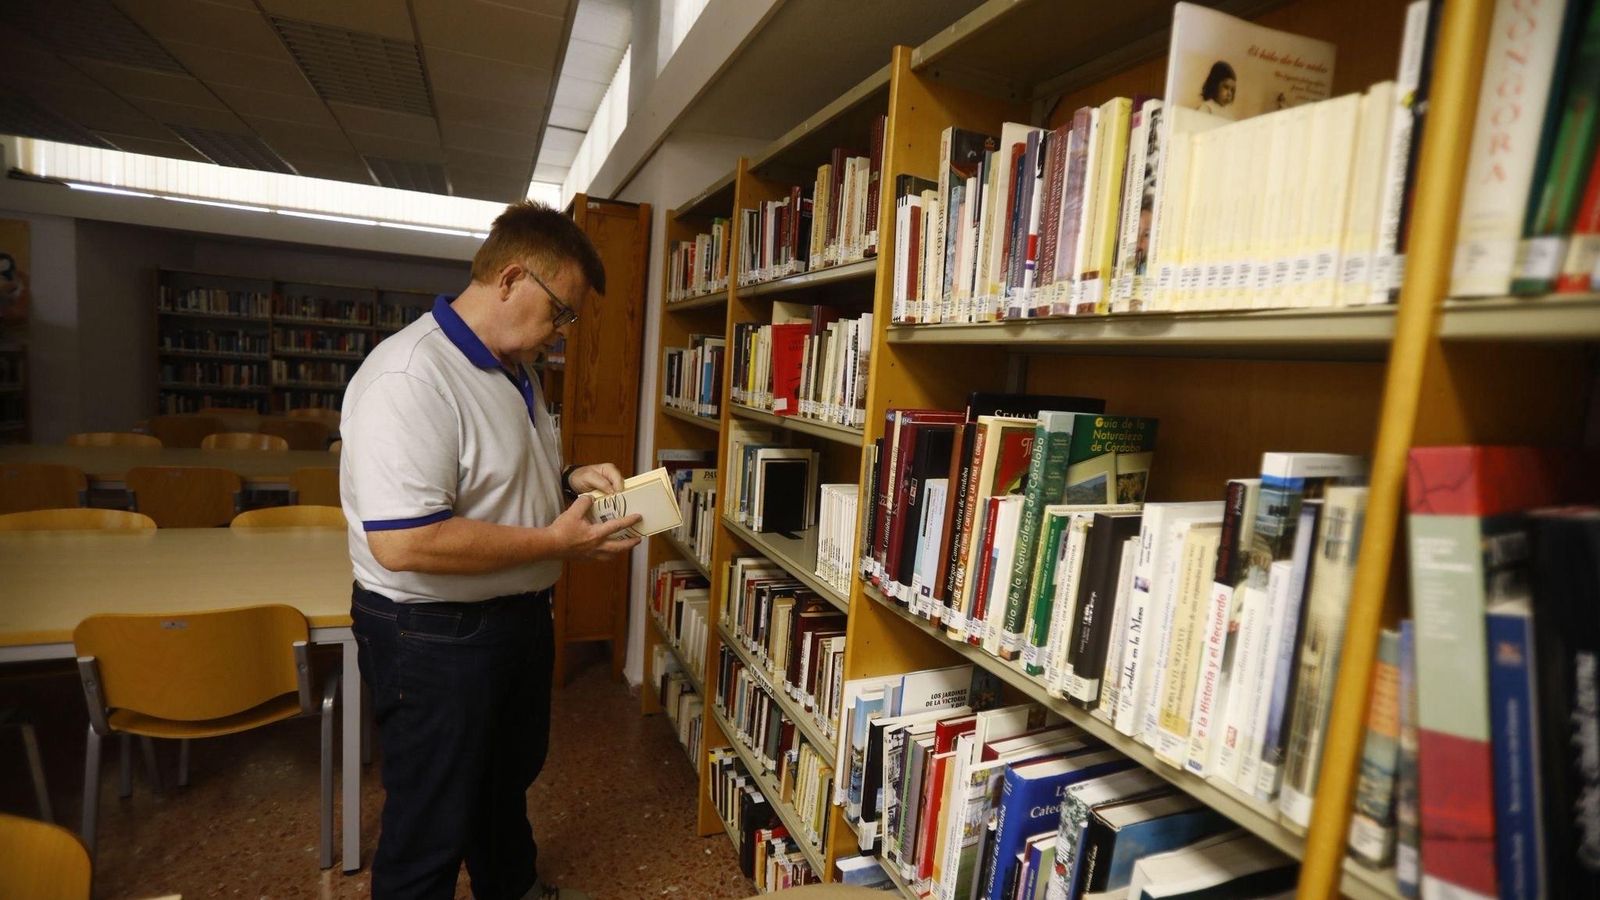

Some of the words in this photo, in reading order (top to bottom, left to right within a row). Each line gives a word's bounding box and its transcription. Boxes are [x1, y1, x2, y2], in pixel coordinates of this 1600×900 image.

[1091, 440, 1102, 452] de
[1031, 437, 1045, 488] Córdoba
[1027, 492, 1035, 506] de
[965, 503, 973, 527] CARTELES
[947, 563, 956, 591] Bodegas
[952, 532, 962, 562] Campos,
[959, 498, 965, 506] de
[1017, 511, 1032, 574] Naturaleza
[1013, 578, 1021, 588] la
[1010, 591, 1019, 606] de
[1007, 609, 1016, 633] Guía
[1131, 606, 1144, 632] Mesa
[1211, 593, 1226, 644] Recuerdo
[1130, 648, 1137, 658] en
[1209, 647, 1217, 657] el
[931, 692, 941, 700] LOS
[942, 689, 967, 699] JARDINES
[941, 696, 967, 705] VICTORIA
[1200, 671, 1215, 714] Historia
[1200, 716, 1207, 727] la
[988, 858, 997, 893] Catedral
[993, 845, 1000, 855] de
